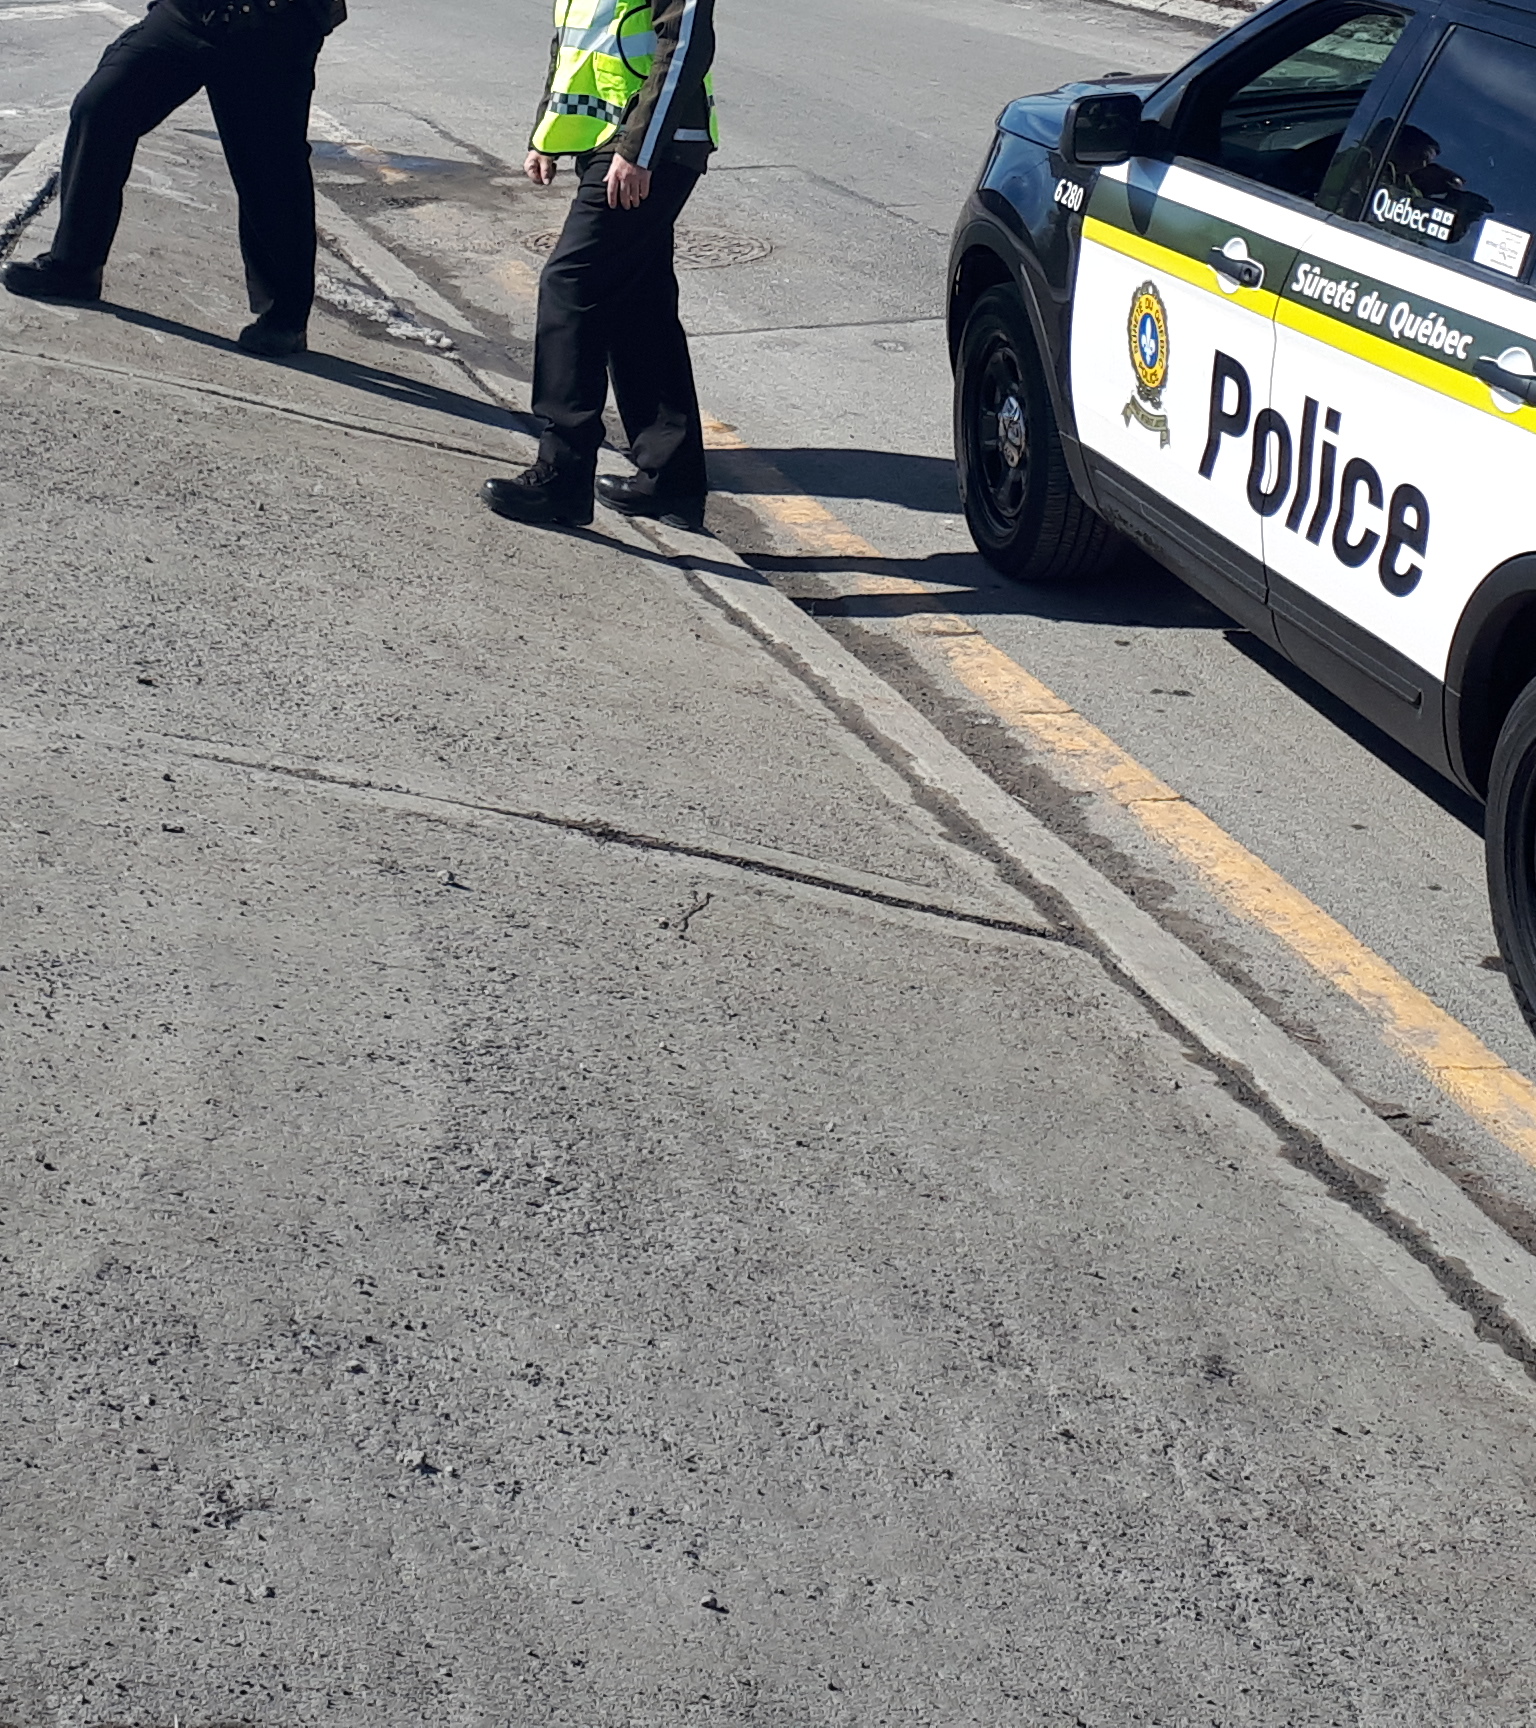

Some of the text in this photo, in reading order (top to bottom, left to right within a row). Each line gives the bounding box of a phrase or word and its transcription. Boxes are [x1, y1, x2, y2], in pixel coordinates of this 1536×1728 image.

[1054, 178, 1084, 212] 6280
[1373, 188, 1430, 233] Québec
[1291, 262, 1474, 360] Sûreté du Québec
[1198, 349, 1431, 597] Police
